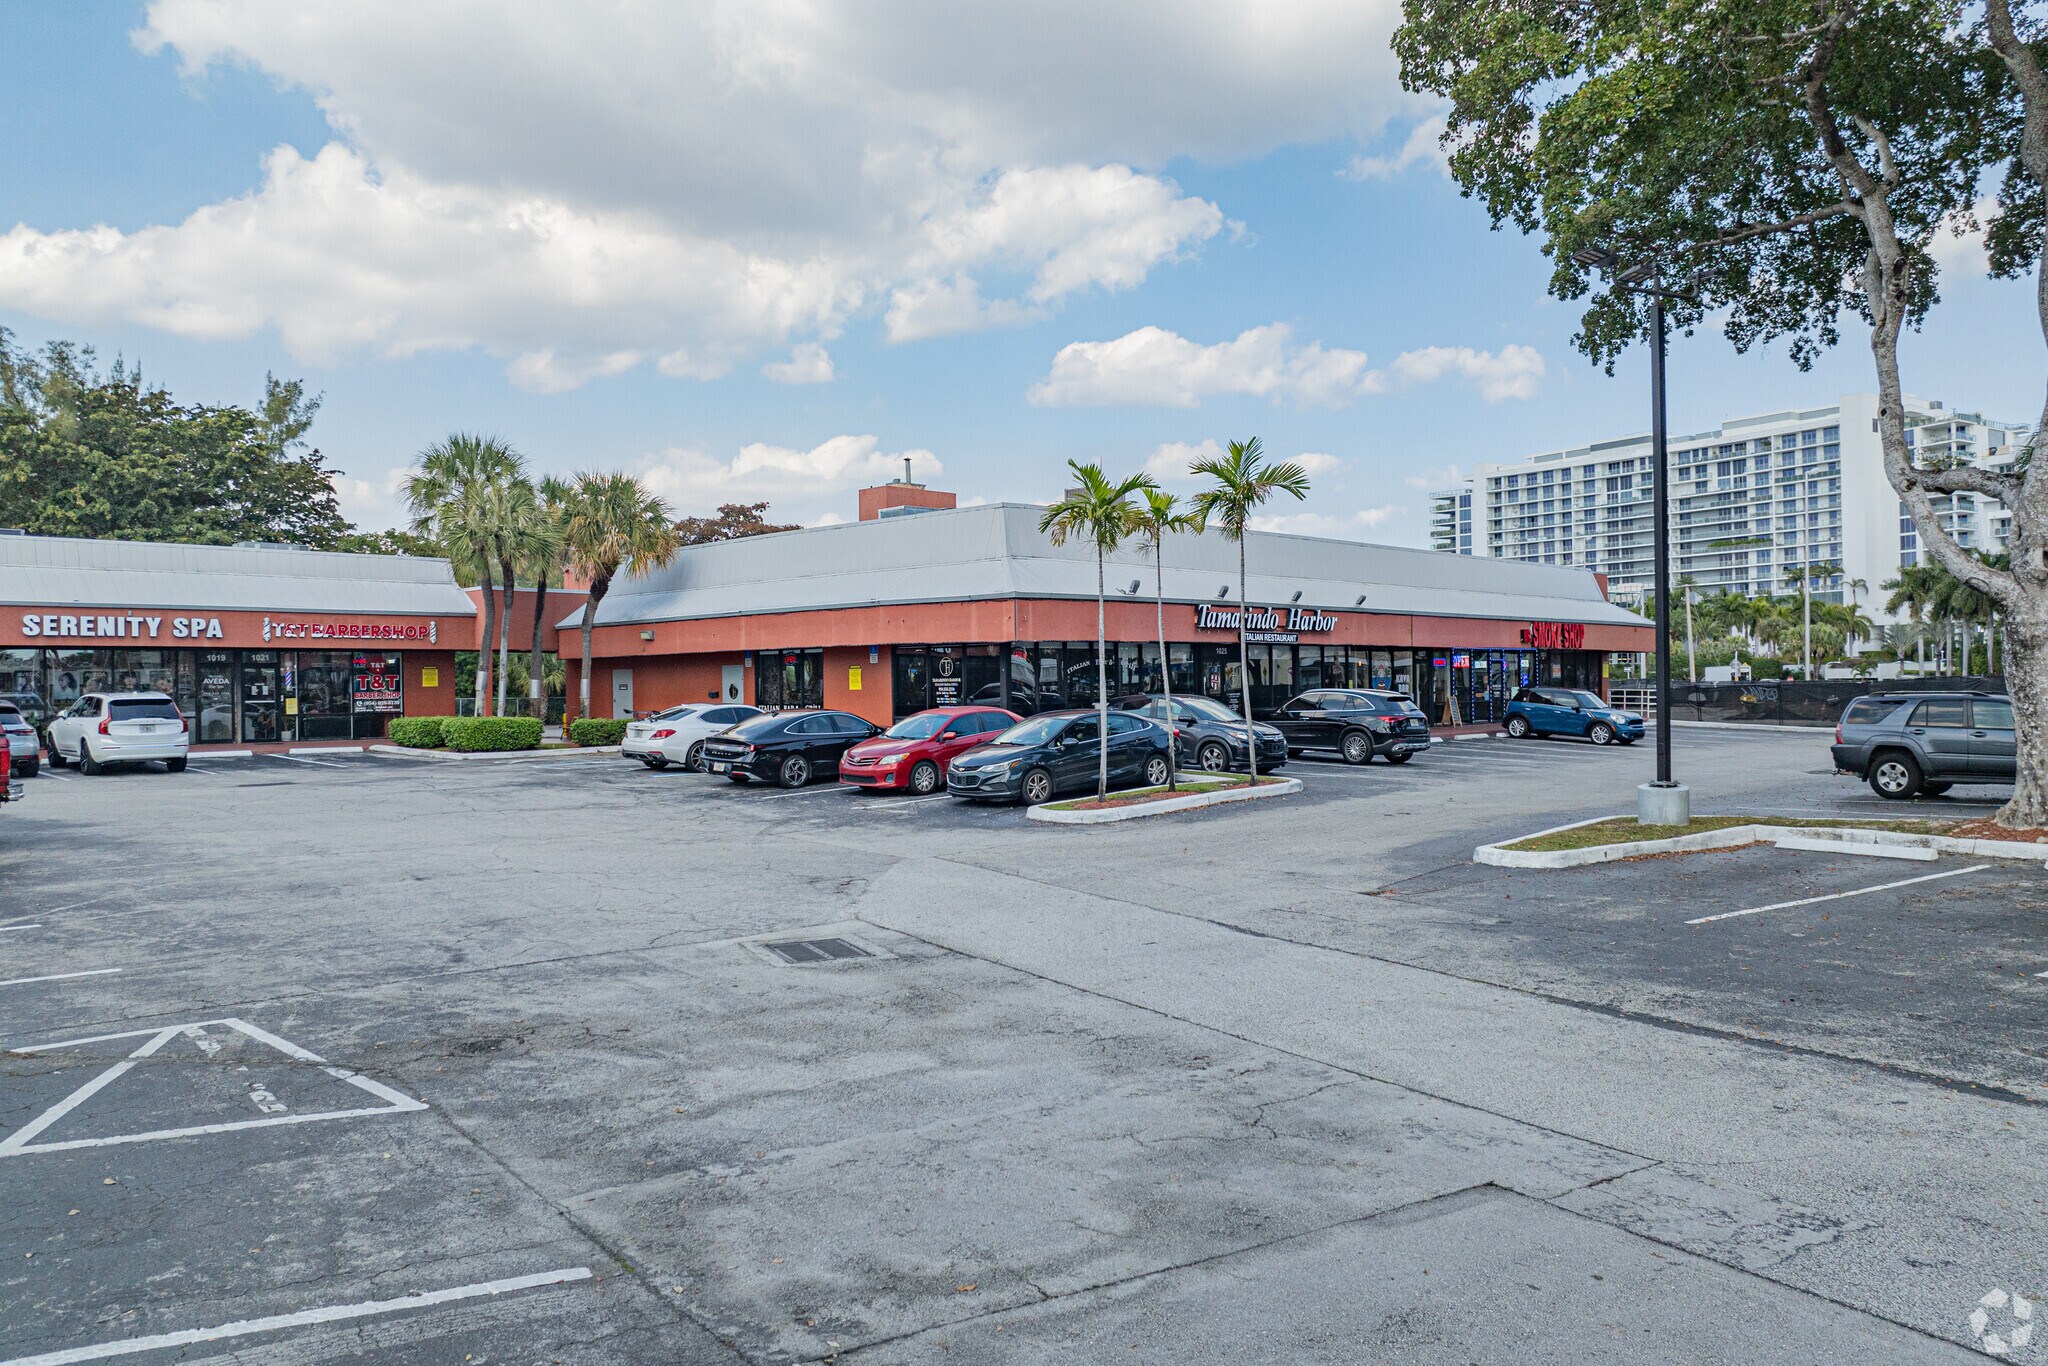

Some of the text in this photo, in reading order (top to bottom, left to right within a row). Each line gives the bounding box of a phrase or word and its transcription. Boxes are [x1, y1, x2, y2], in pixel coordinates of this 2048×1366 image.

[22, 614, 224, 638] SERENITY SPA
[1287, 607, 1338, 631] Harbor
[272, 623, 430, 640] T&T BARBERSHOP
[1245, 633, 1297, 643] TALIAN RESTAURANT
[1533, 621, 1585, 649] SMOKE SHOP
[206, 654, 226, 662] 1019
[1066, 660, 1091, 675] ITALIAN
[356, 674, 399, 691] T&T
[354, 691, 401, 700] BARBER SHOP
